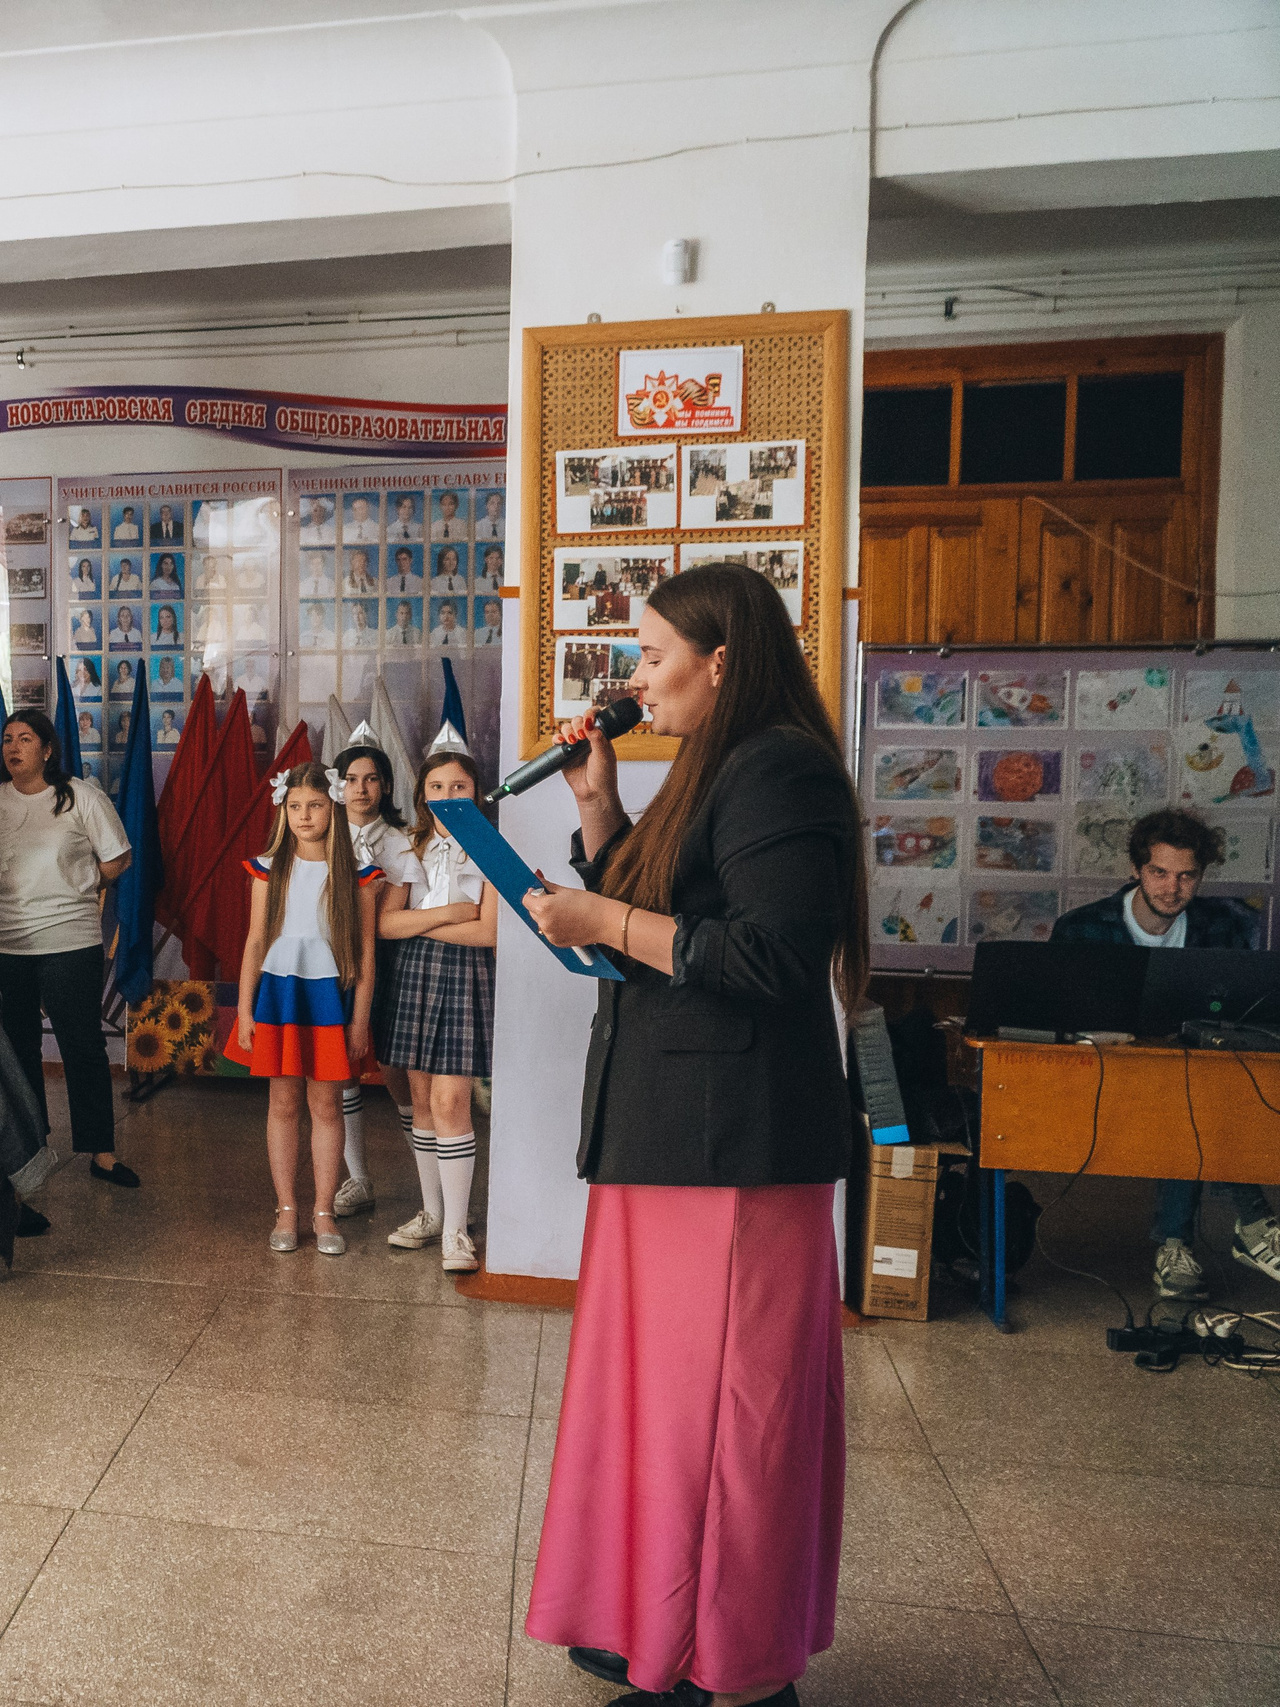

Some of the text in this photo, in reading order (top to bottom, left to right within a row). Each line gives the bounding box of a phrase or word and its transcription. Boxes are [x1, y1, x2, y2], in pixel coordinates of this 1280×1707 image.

[7, 397, 506, 444] НОВОТИТАРОВСКАЯ СРЕДНЯЯ ОБЩЕОБРАЗОВАТЕЛЬНАЯ
[61, 480, 276, 500] УЧИТЕЛЯМИ СЛАВИТСЯ РОССИЯ
[292, 477, 359, 491] УЧЕНИКИ
[362, 474, 441, 489] ПРИНОСЯТ
[443, 473, 490, 486] СЛАВУ
